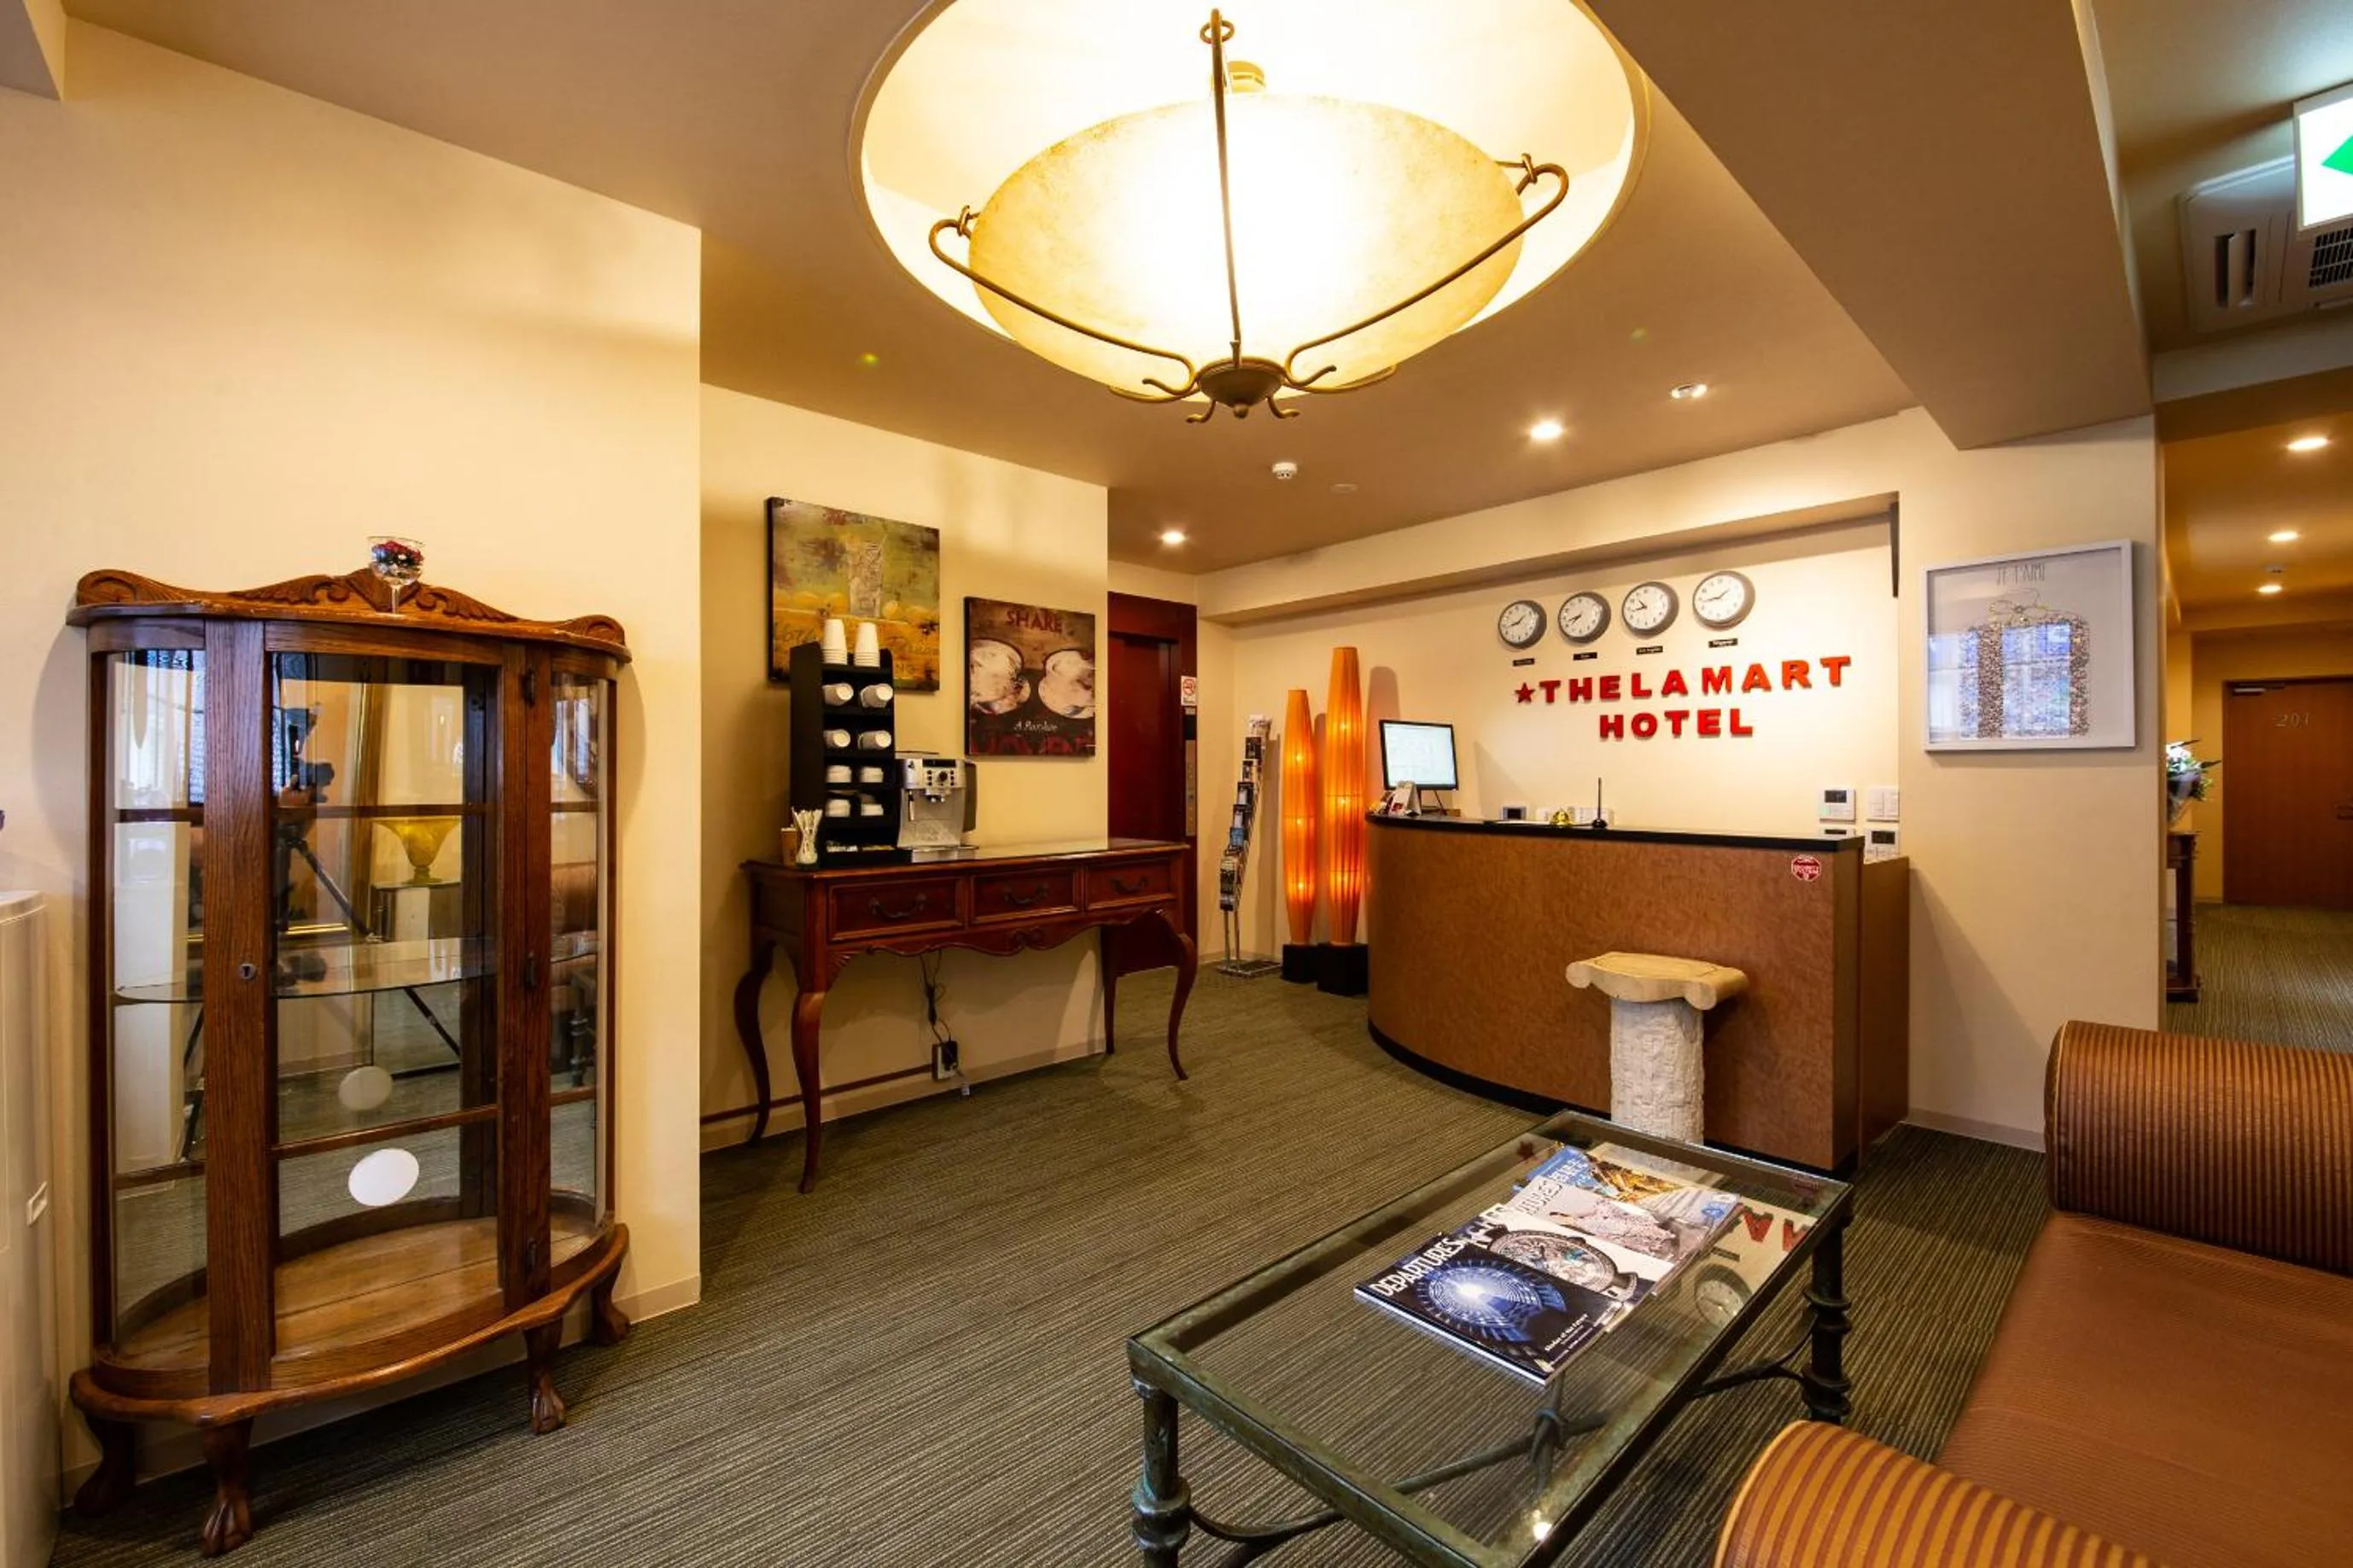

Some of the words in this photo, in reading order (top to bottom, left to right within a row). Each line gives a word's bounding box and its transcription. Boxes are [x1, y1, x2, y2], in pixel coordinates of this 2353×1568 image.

[1006, 609, 1063, 633] SHARE
[1599, 708, 1754, 739] HOTEL
[2274, 713, 2309, 728] 201
[1369, 1237, 1465, 1297] DEPARTURES
